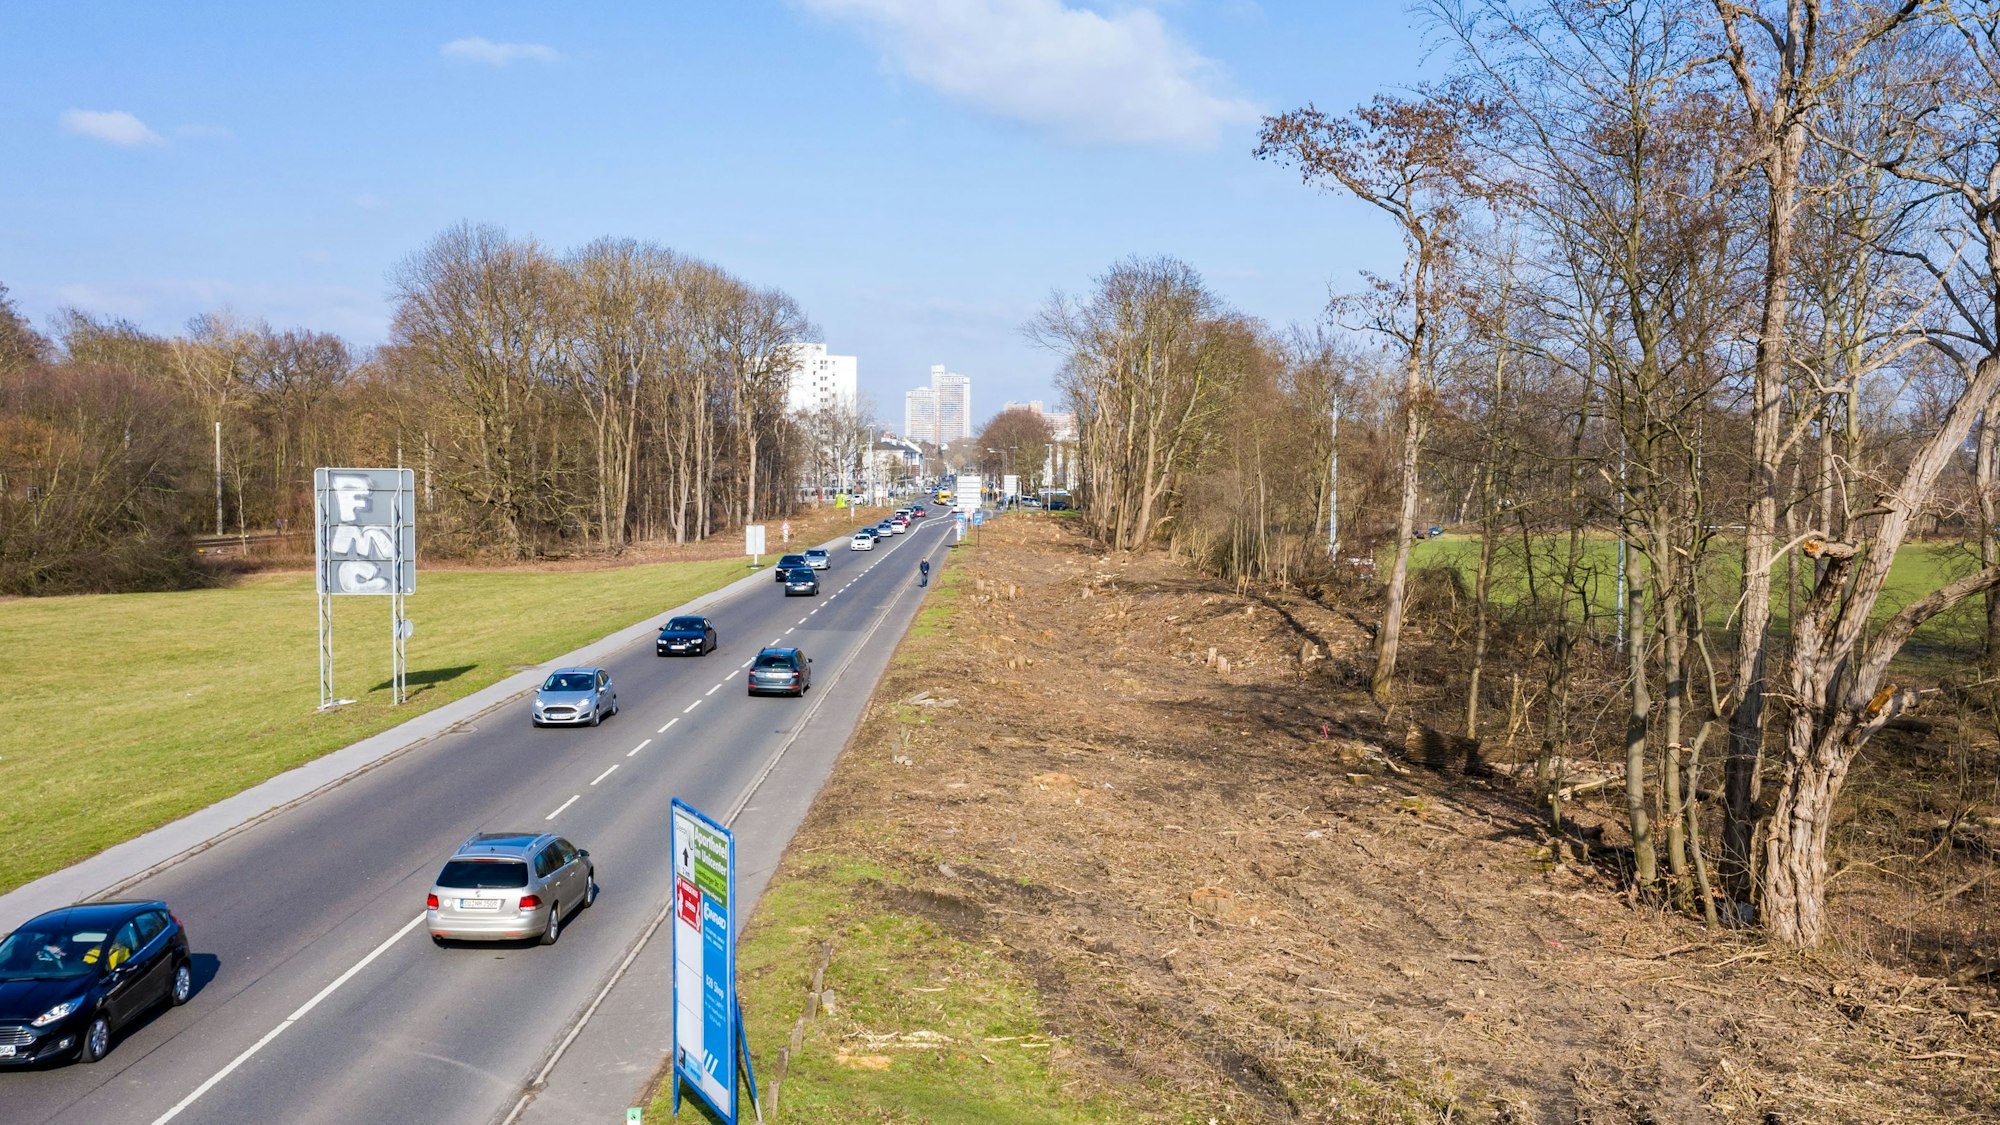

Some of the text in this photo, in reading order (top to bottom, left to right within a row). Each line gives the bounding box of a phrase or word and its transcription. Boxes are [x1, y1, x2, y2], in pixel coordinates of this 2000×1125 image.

[695, 826, 728, 860] Aparthotel
[701, 849, 727, 876] Unicenter
[703, 901, 726, 930] CONRAD
[713, 980, 724, 1000] Shop
